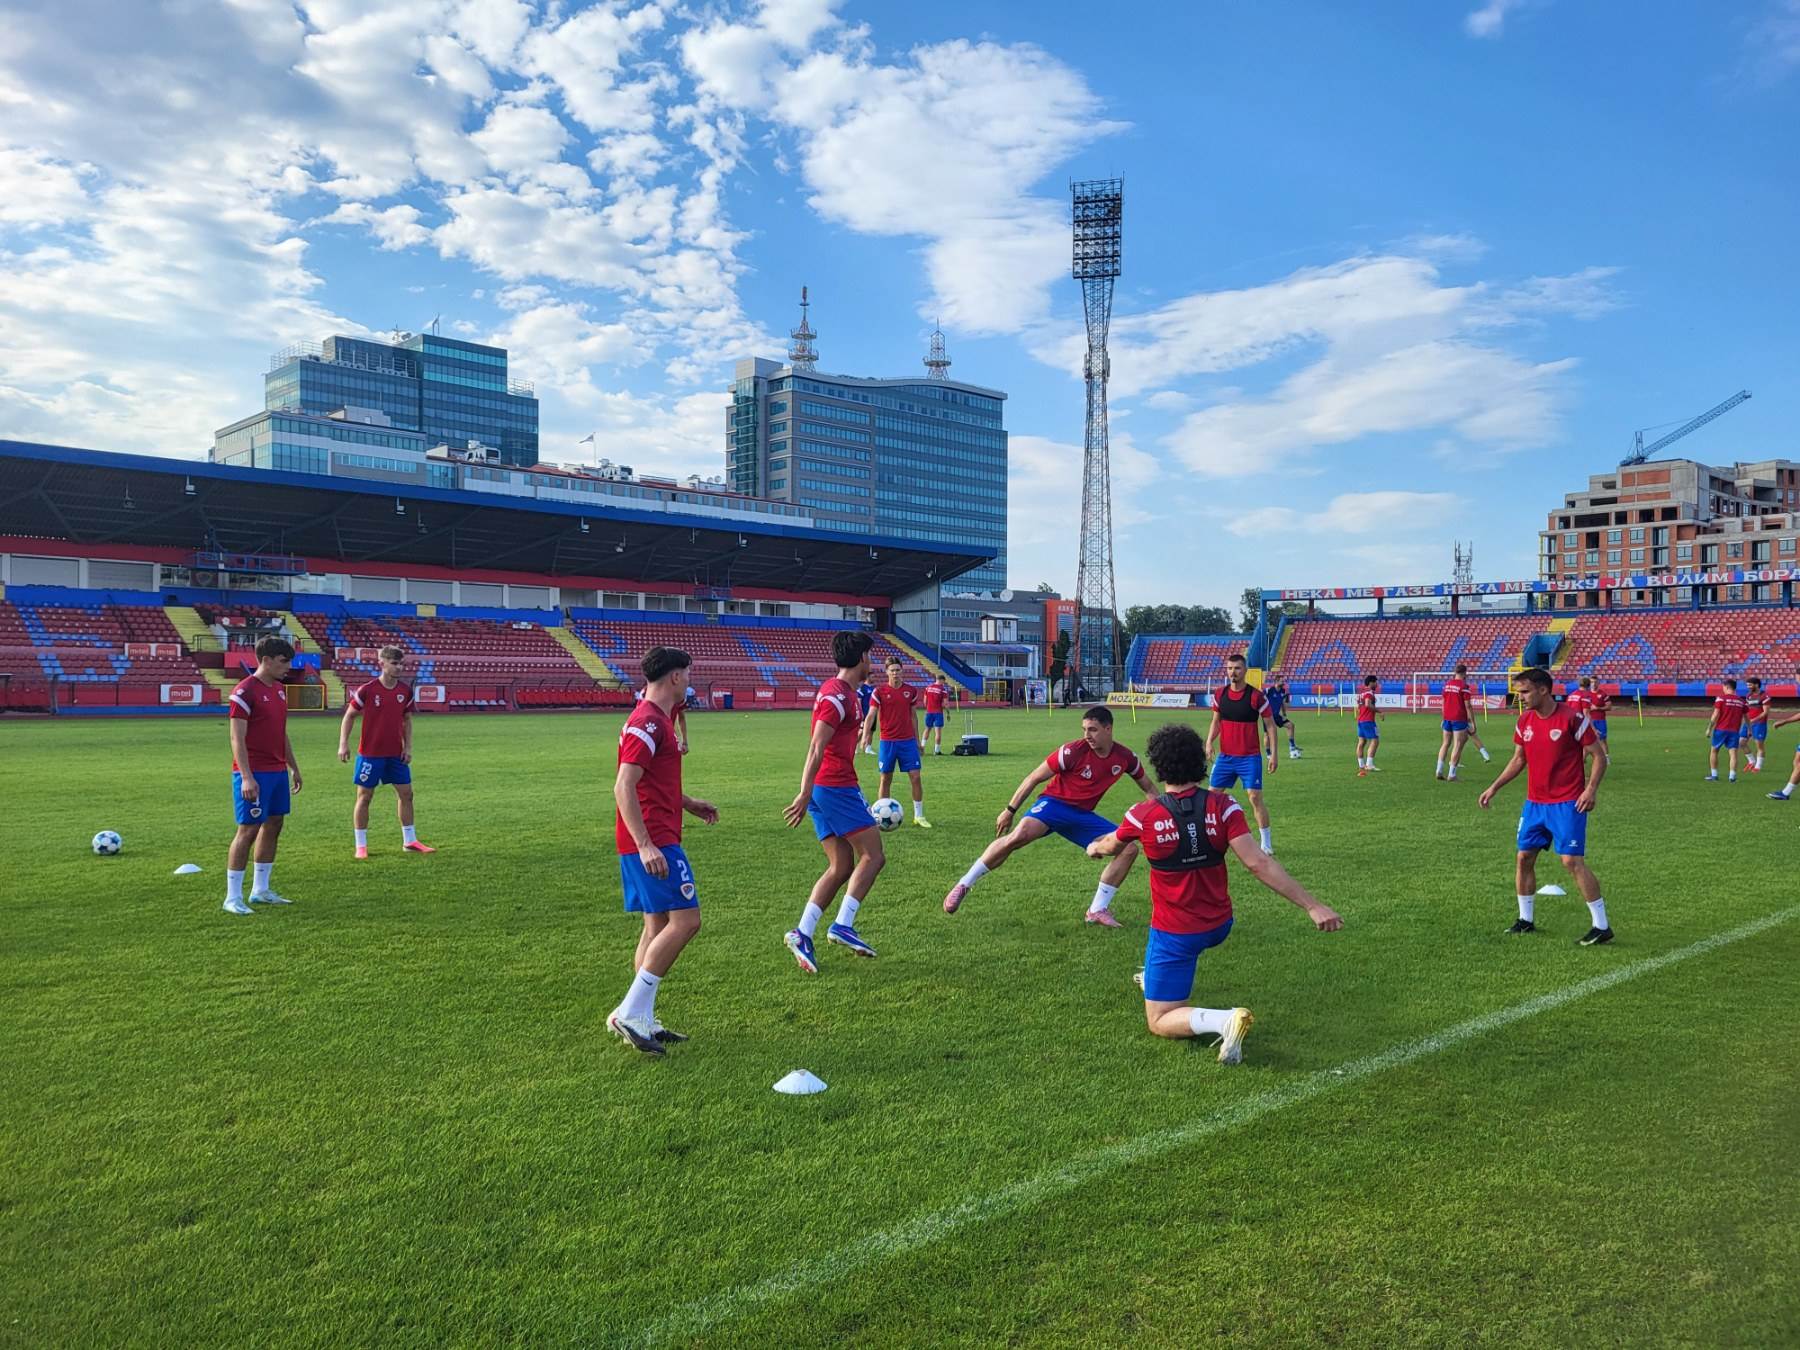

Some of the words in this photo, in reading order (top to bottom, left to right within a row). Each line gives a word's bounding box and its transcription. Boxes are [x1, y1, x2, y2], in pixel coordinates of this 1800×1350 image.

[1285, 589, 1337, 600] НЕКА
[1345, 588, 1375, 598] МЕ
[1443, 584, 1498, 595] НЕКА
[1504, 582, 1534, 593] МЕ
[1647, 572, 1730, 586] ВОЛИМ
